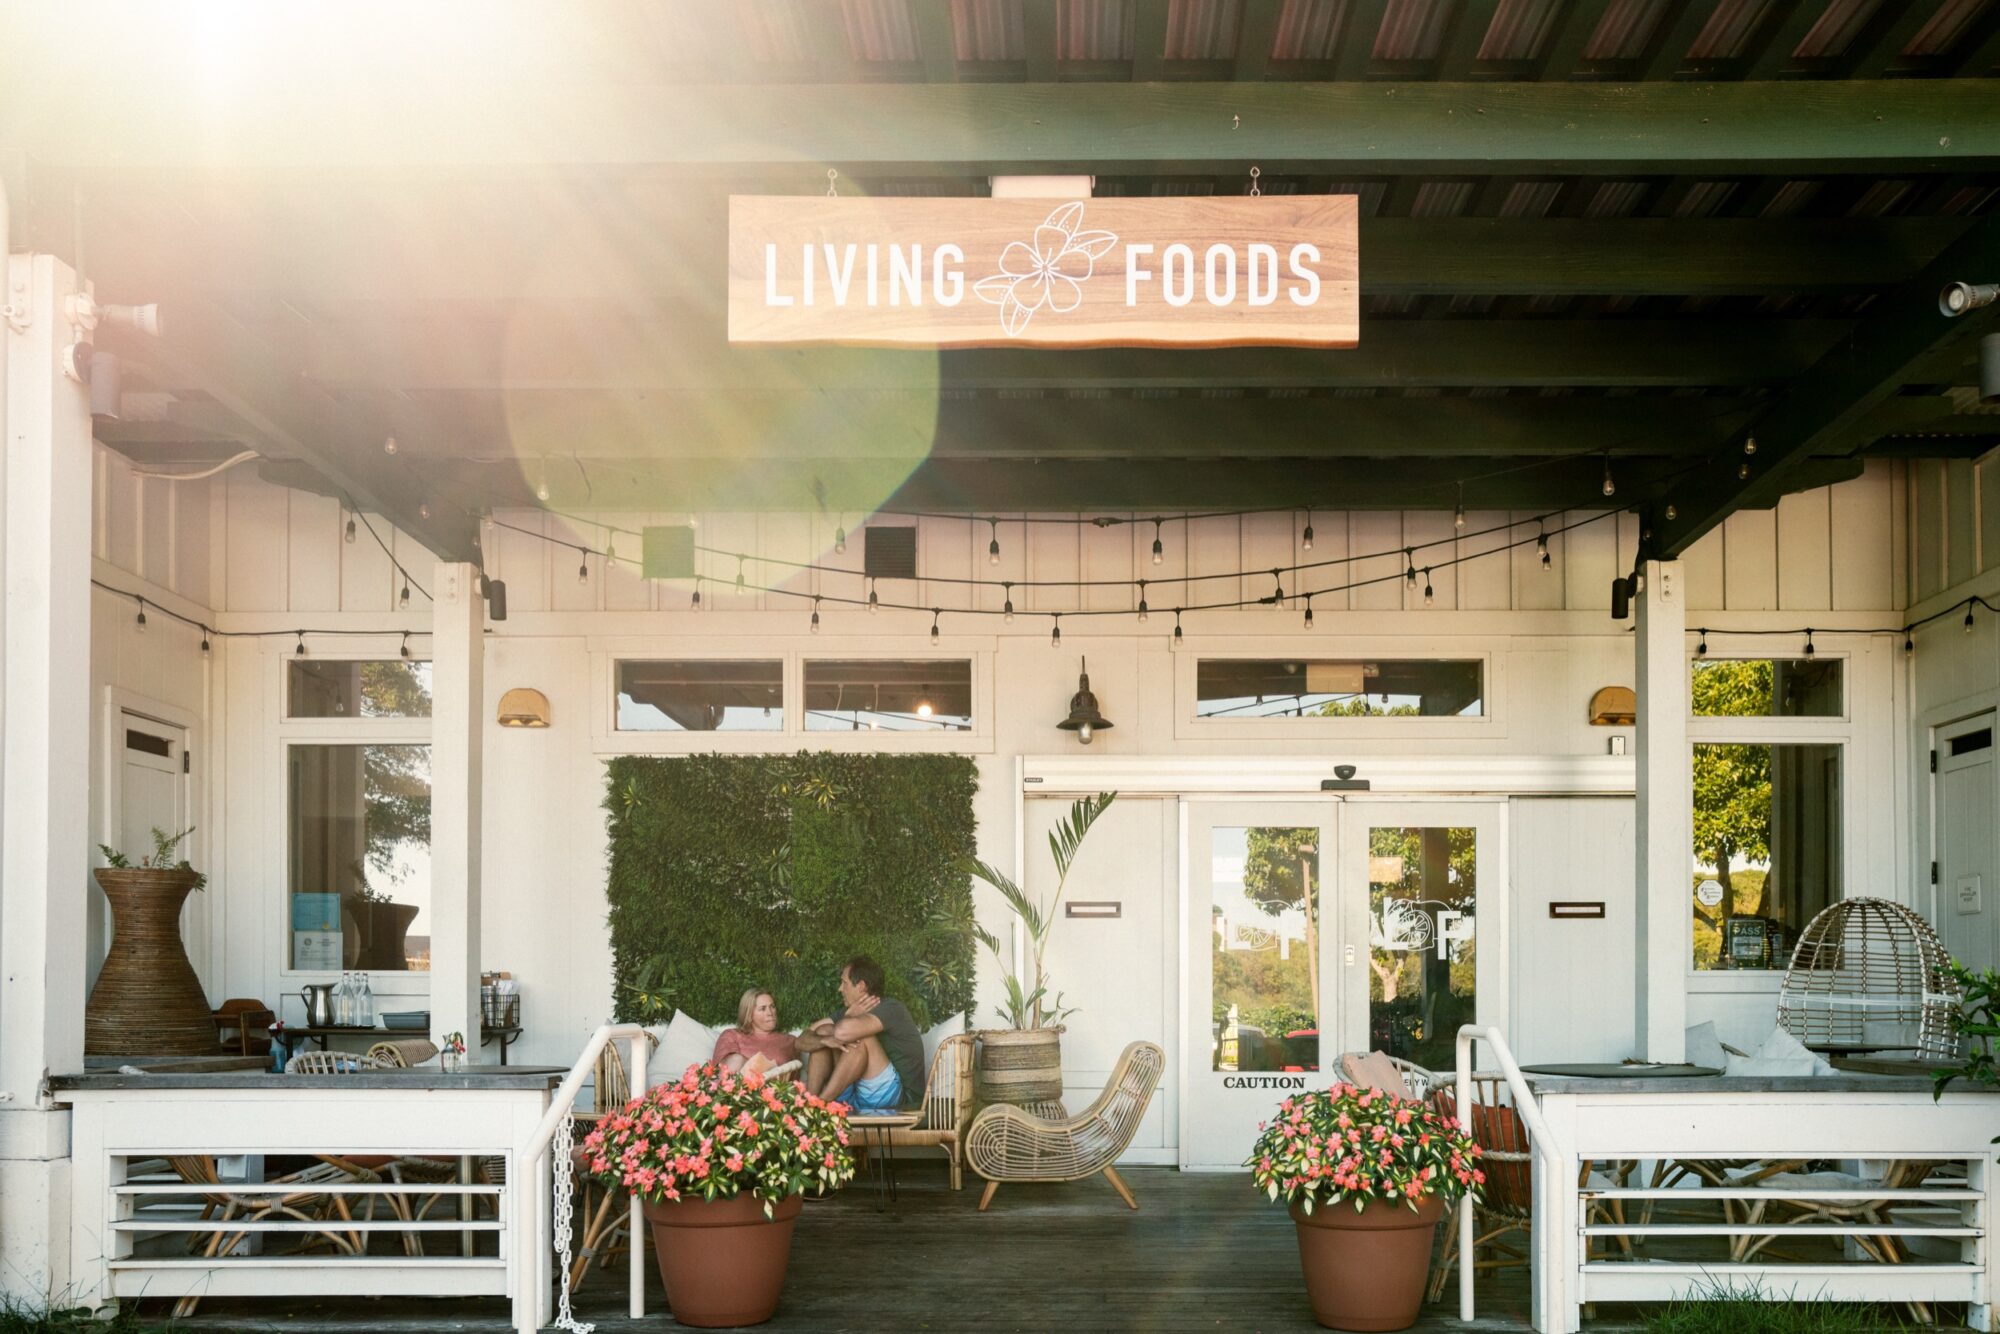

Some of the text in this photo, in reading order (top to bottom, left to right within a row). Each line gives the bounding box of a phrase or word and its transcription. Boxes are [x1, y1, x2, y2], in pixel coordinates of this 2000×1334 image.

[765, 243, 1322, 307] LIVING FOODS
[1733, 926, 1760, 936] PASS
[1223, 1076, 1306, 1089] CAUTION
